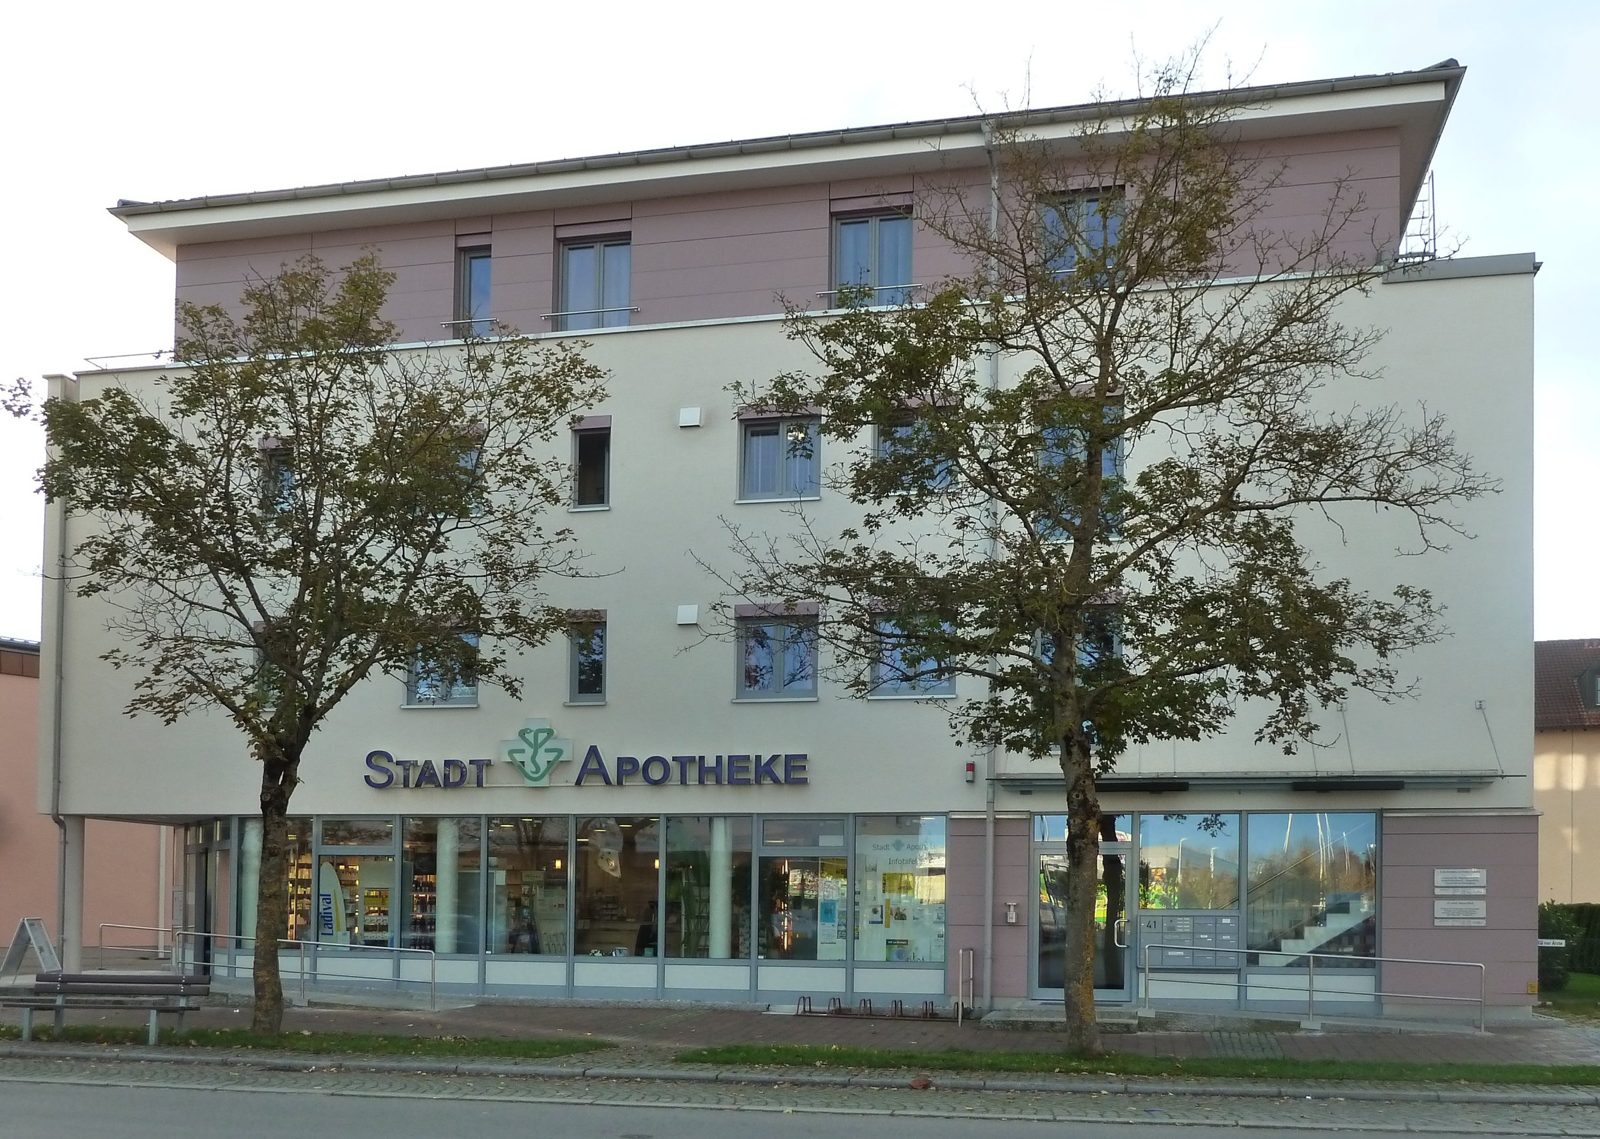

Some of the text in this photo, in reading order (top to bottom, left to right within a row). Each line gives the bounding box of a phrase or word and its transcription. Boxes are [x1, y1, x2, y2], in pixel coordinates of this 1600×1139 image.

[364, 745, 809, 789] STADT APOTHEKE
[319, 893, 334, 937] Ladival
[1146, 920, 1157, 929] 41
